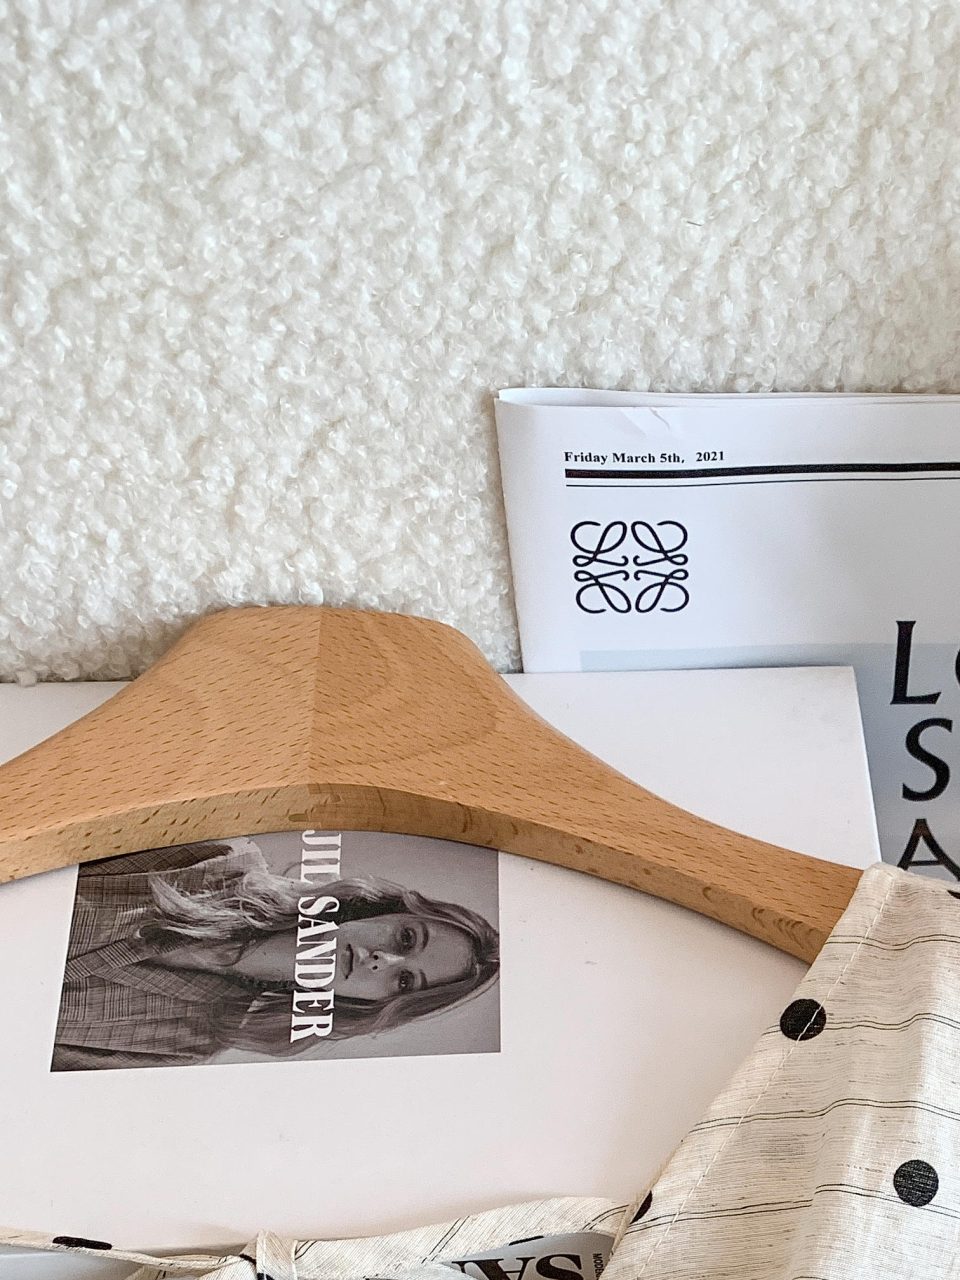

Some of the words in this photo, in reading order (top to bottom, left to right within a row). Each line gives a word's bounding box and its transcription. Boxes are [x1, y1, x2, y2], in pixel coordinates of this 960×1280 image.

[564, 451, 608, 465] Friday
[612, 452, 656, 463] March
[660, 452, 685, 463] 5th,
[695, 451, 725, 462] 2021
[301, 829, 342, 885] JIL
[289, 896, 341, 1044] SANDER
